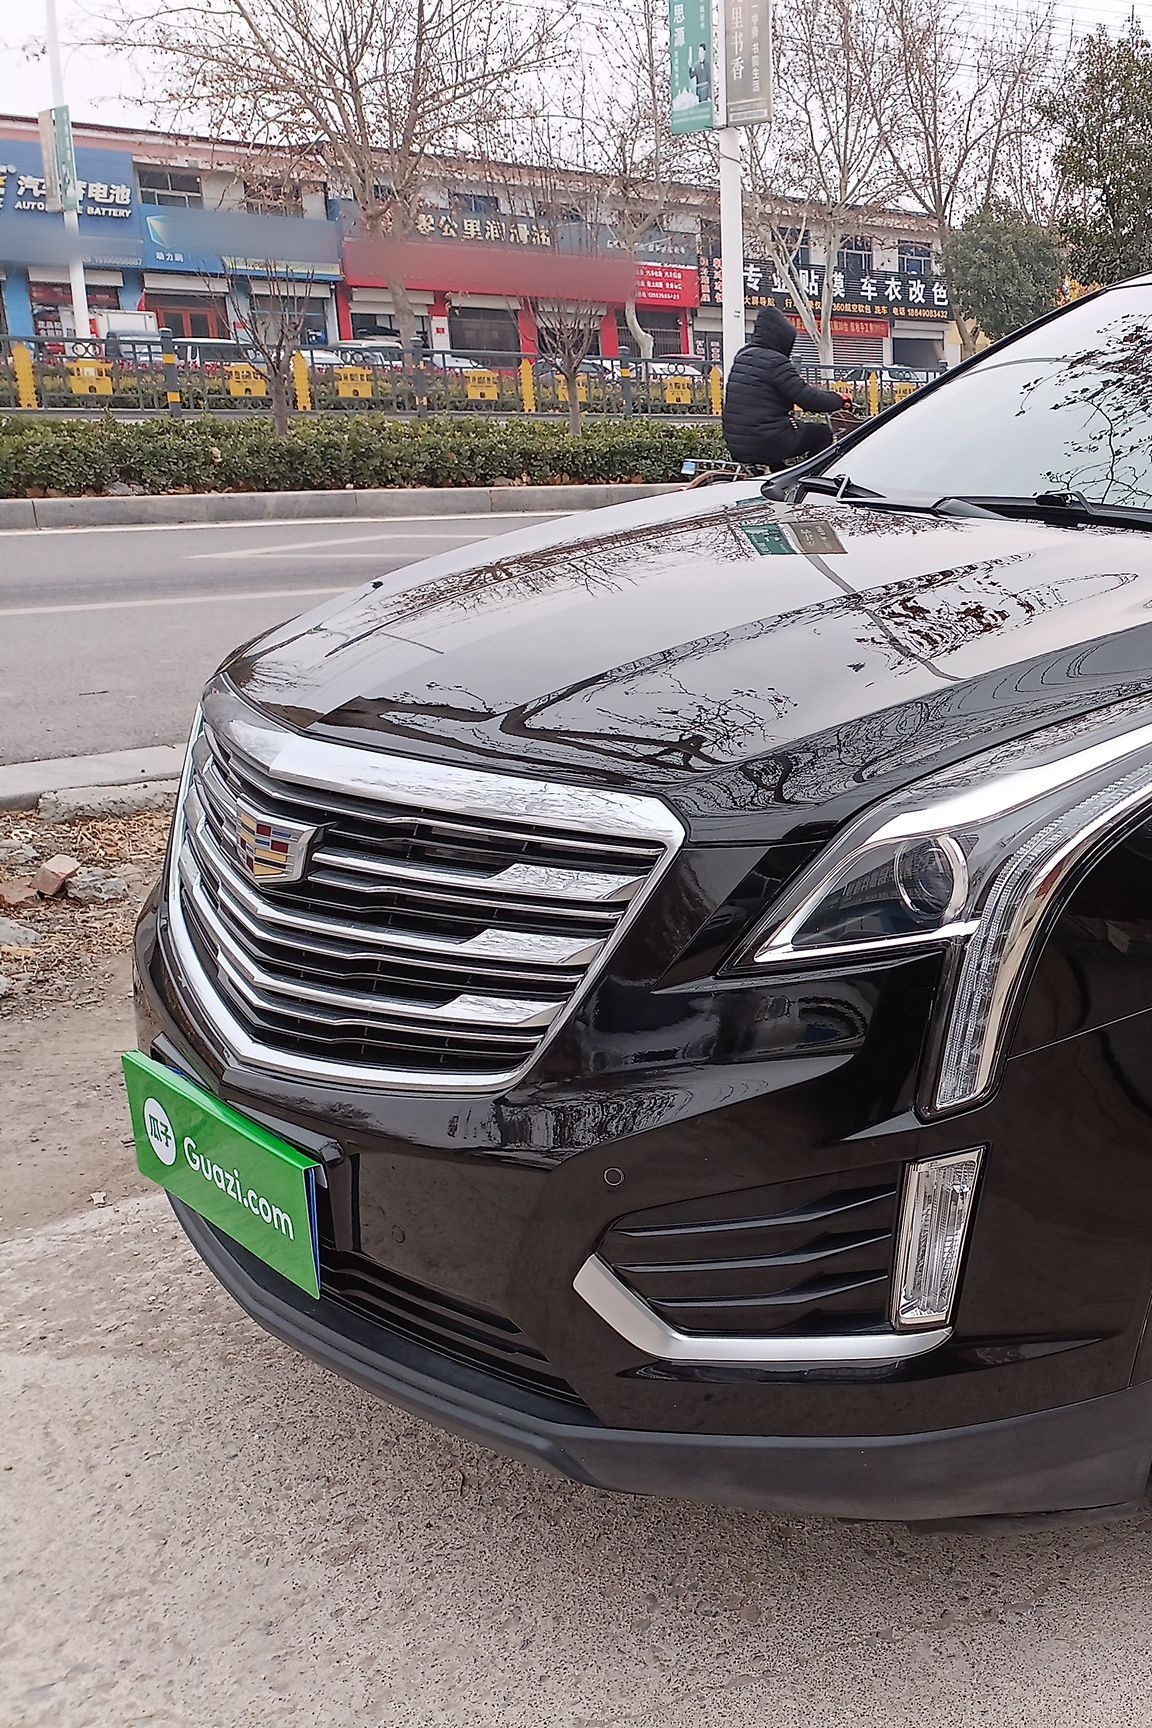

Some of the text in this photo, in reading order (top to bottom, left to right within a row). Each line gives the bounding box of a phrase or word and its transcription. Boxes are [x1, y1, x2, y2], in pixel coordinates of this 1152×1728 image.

[87, 206, 131, 217] BATTERY
[860, 276, 949, 306] 车衣改色
[149, 1113, 172, 1148] 瓜子
[183, 1136, 295, 1241] Guazi.com
